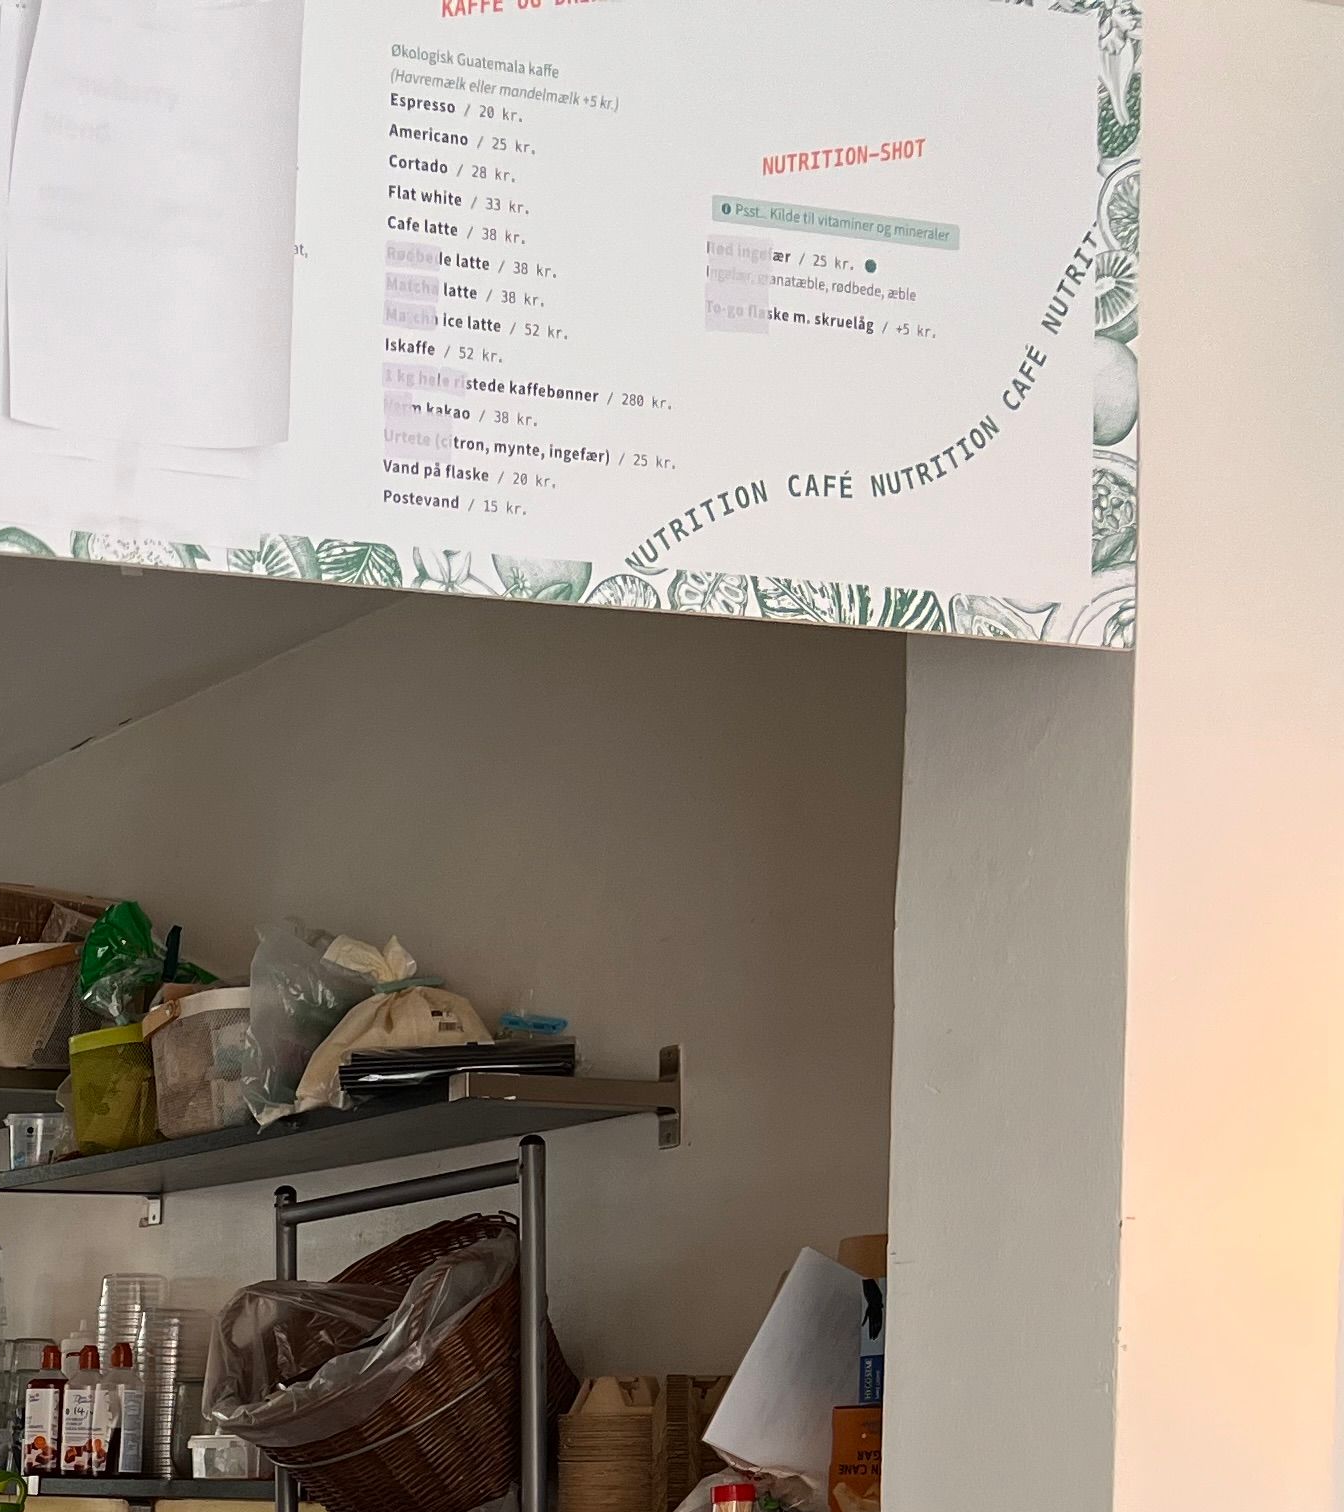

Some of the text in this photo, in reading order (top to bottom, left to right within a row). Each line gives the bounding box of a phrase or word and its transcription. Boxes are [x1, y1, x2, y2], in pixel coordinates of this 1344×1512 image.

[391, 44, 559, 79] Økologisk Guatemala kaffe
[391, 68, 619, 113] (Havremælk eller mandelmælk +5 kr.)
[390, 93, 523, 123] Espresso 20 kr.
[389, 124, 536, 155] Americano 25 kr.
[389, 155, 516, 182] Cortado 28 kr.
[388, 185, 530, 215] Flat white 33 kr.
[387, 216, 526, 245] Cafe latte 38 kr.
[771, 208, 950, 241] Kilde til vitaminer og mineraler
[456, 254, 557, 279] latte 38 kr.
[813, 255, 854, 270] 25 kr.
[444, 283, 545, 308] latte 38 kr.
[832, 283, 917, 301] rødbede, æble
[443, 313, 568, 340] ice latte 52 kr.
[793, 312, 936, 338] m. skruelåg +5 kr.
[385, 338, 503, 363] Iskaffe 52 kr.
[509, 381, 672, 410] kaffebønner 280 kr.
[494, 411, 538, 427] 38 kr.
[494, 441, 676, 470] mynte, ingefær) 25 kr.
[624, 479, 768, 570] NUTRITION
[787, 471, 853, 499] CAFÉ
[870, 415, 1000, 499] NUTRITION
[1001, 342, 1047, 411] CAFÉ
[383, 459, 556, 489] Vand på flaske 20 kr.
[383, 490, 527, 515] Postevand 15 kr.
